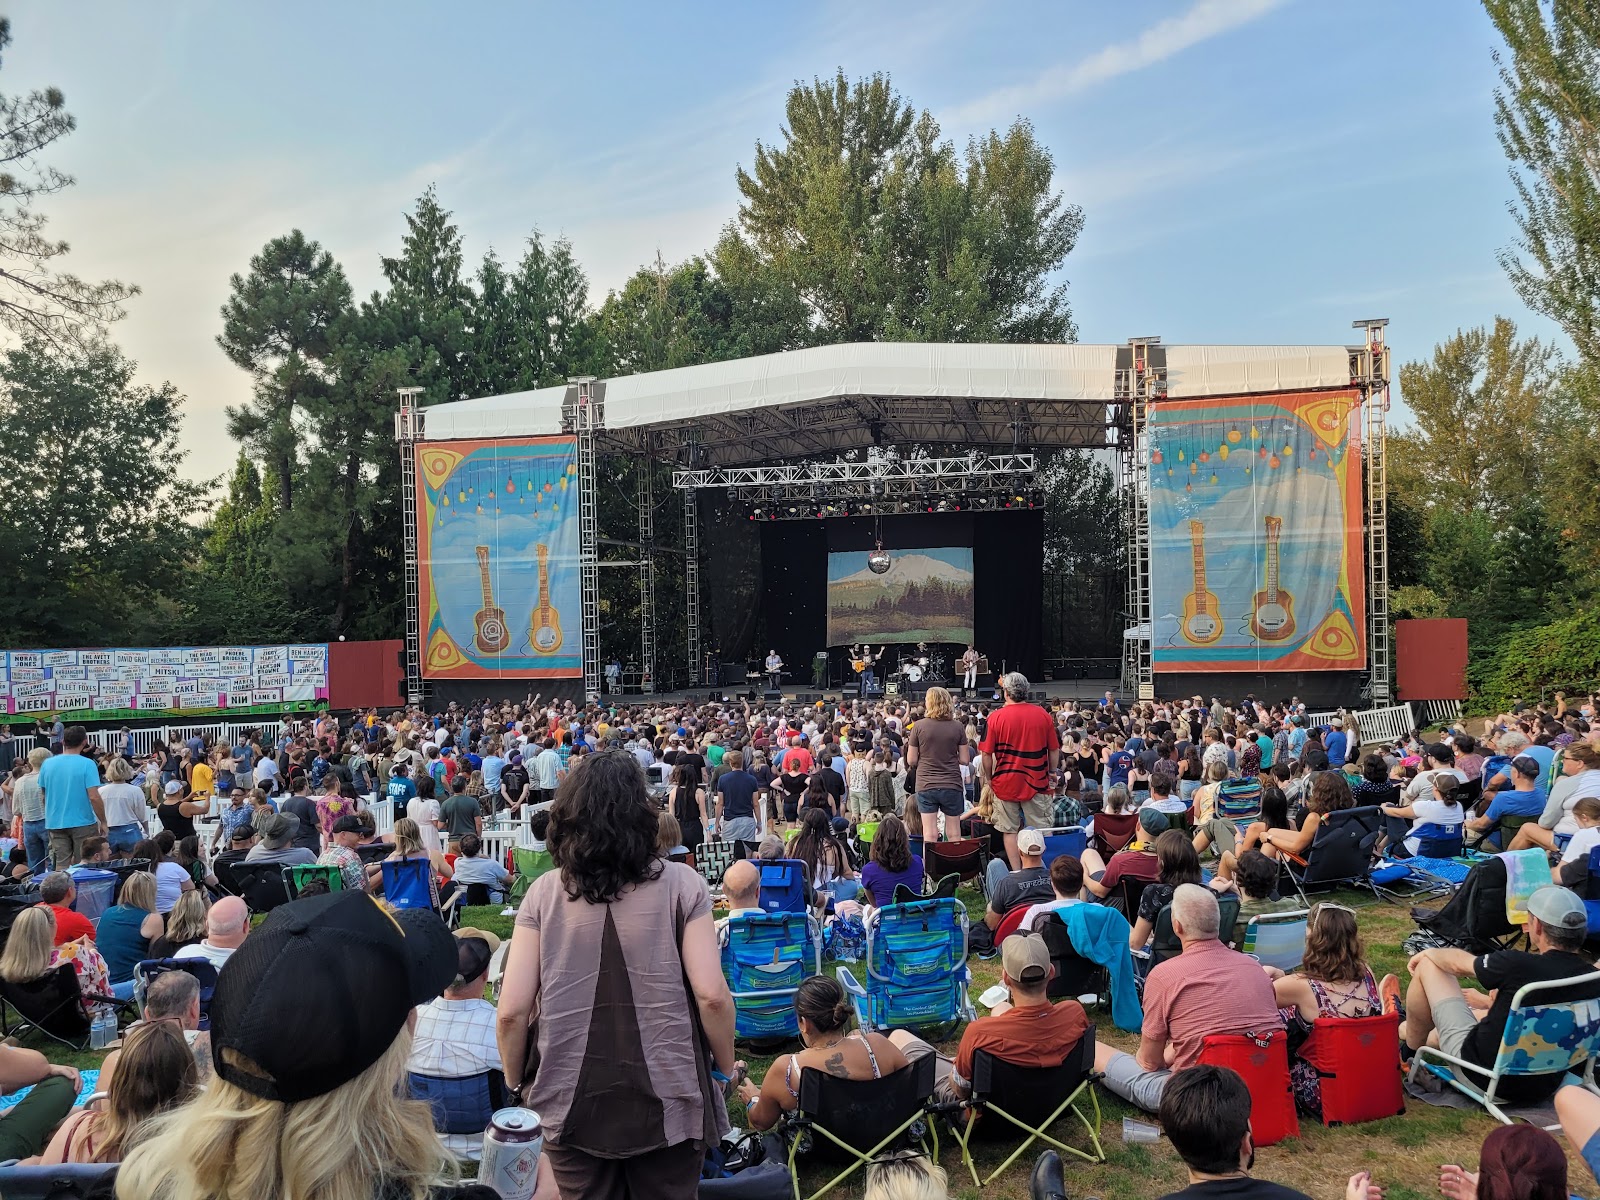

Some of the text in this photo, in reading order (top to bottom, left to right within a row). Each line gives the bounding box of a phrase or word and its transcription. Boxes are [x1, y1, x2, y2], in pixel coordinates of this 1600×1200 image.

[58, 683, 76, 691] FLEET
[261, 678, 289, 686] PAVEMENT
[174, 685, 195, 694] CAKE
[18, 699, 48, 711] WEEN
[57, 697, 87, 708] CAAMP
[388, 782, 407, 796] STAFF
